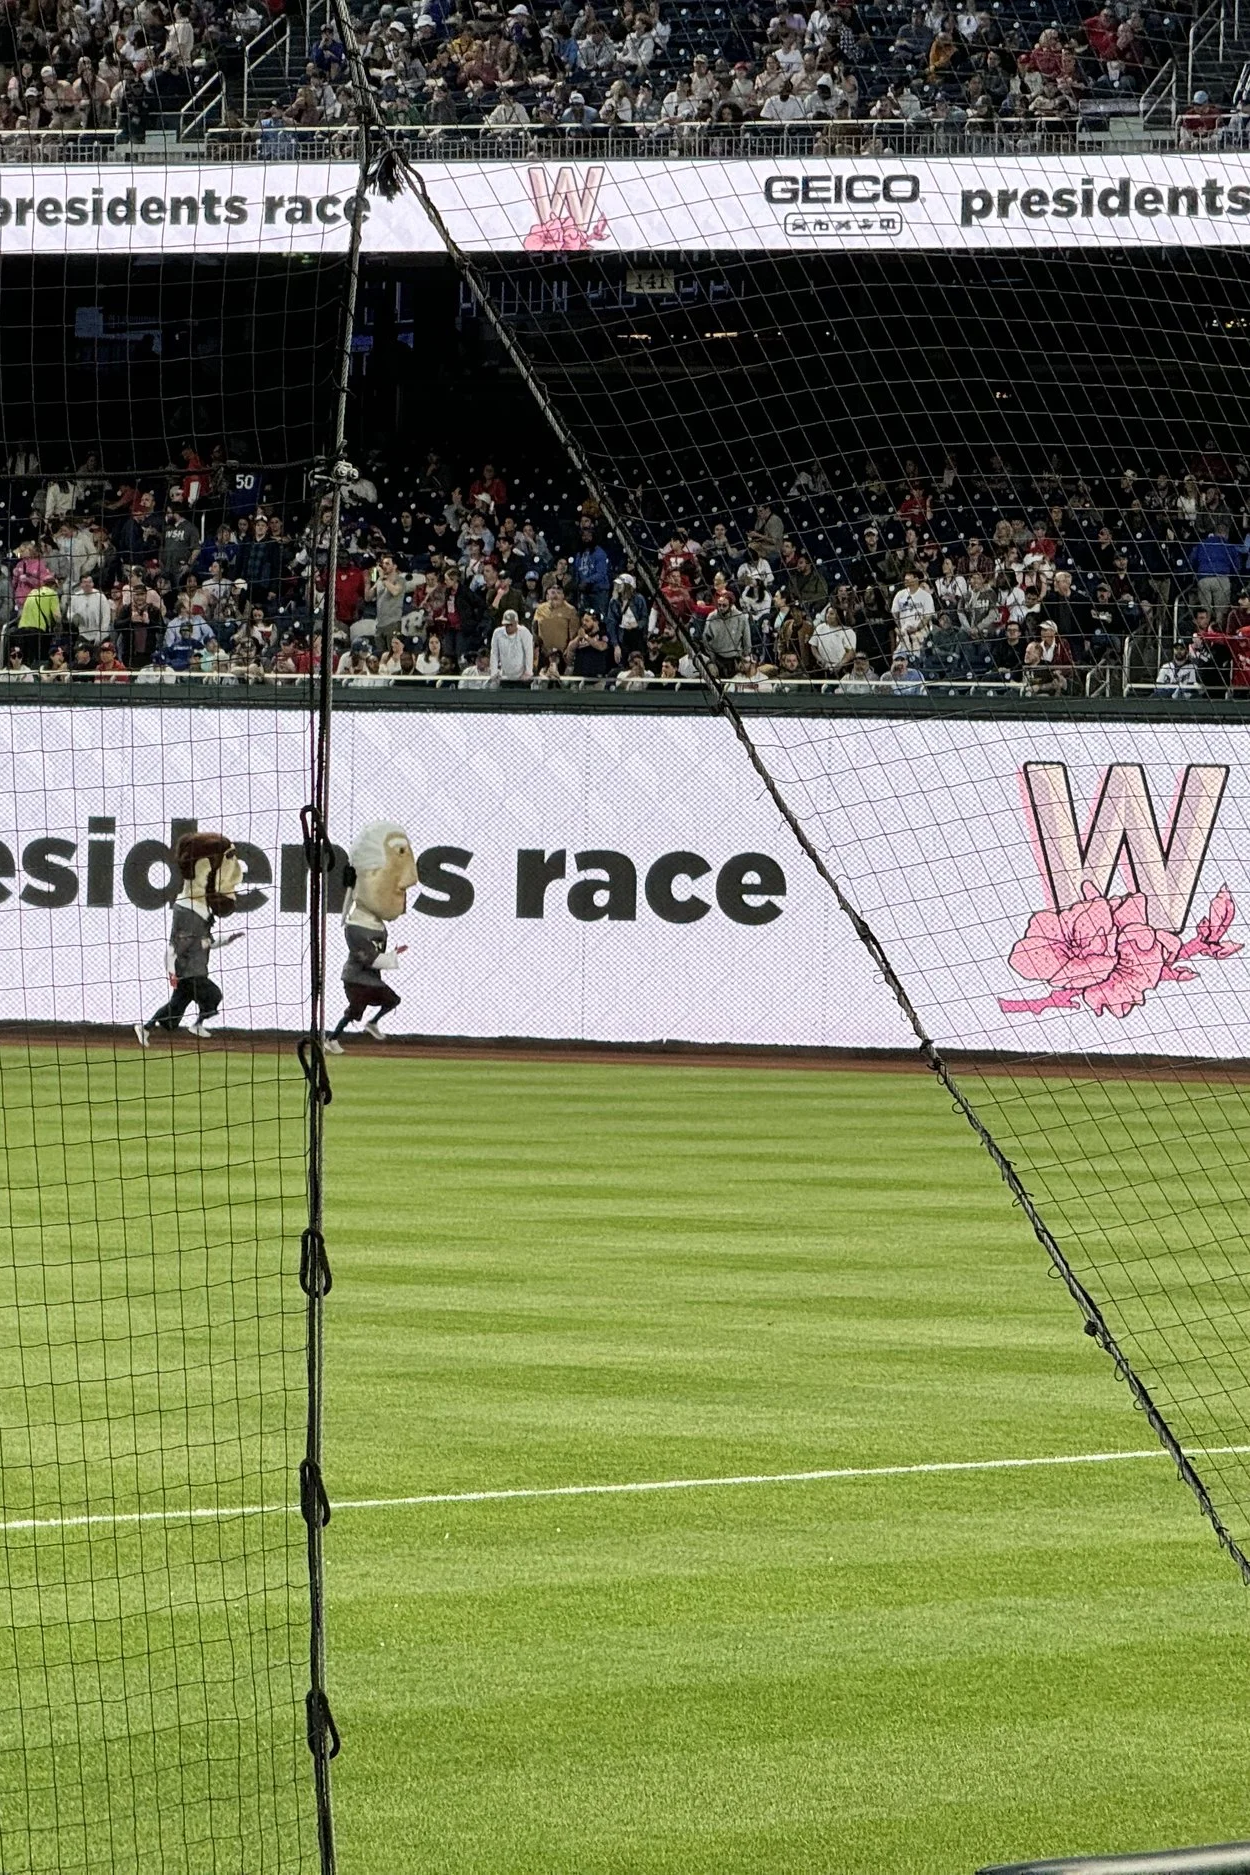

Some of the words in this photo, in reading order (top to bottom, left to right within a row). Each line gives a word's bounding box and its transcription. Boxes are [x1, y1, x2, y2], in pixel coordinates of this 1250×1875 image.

[764, 175, 920, 204] GEICO
[961, 178, 1250, 227] presidents
[264, 190, 371, 225] race
[236, 474, 254, 490] 50
[516, 849, 788, 927] race
